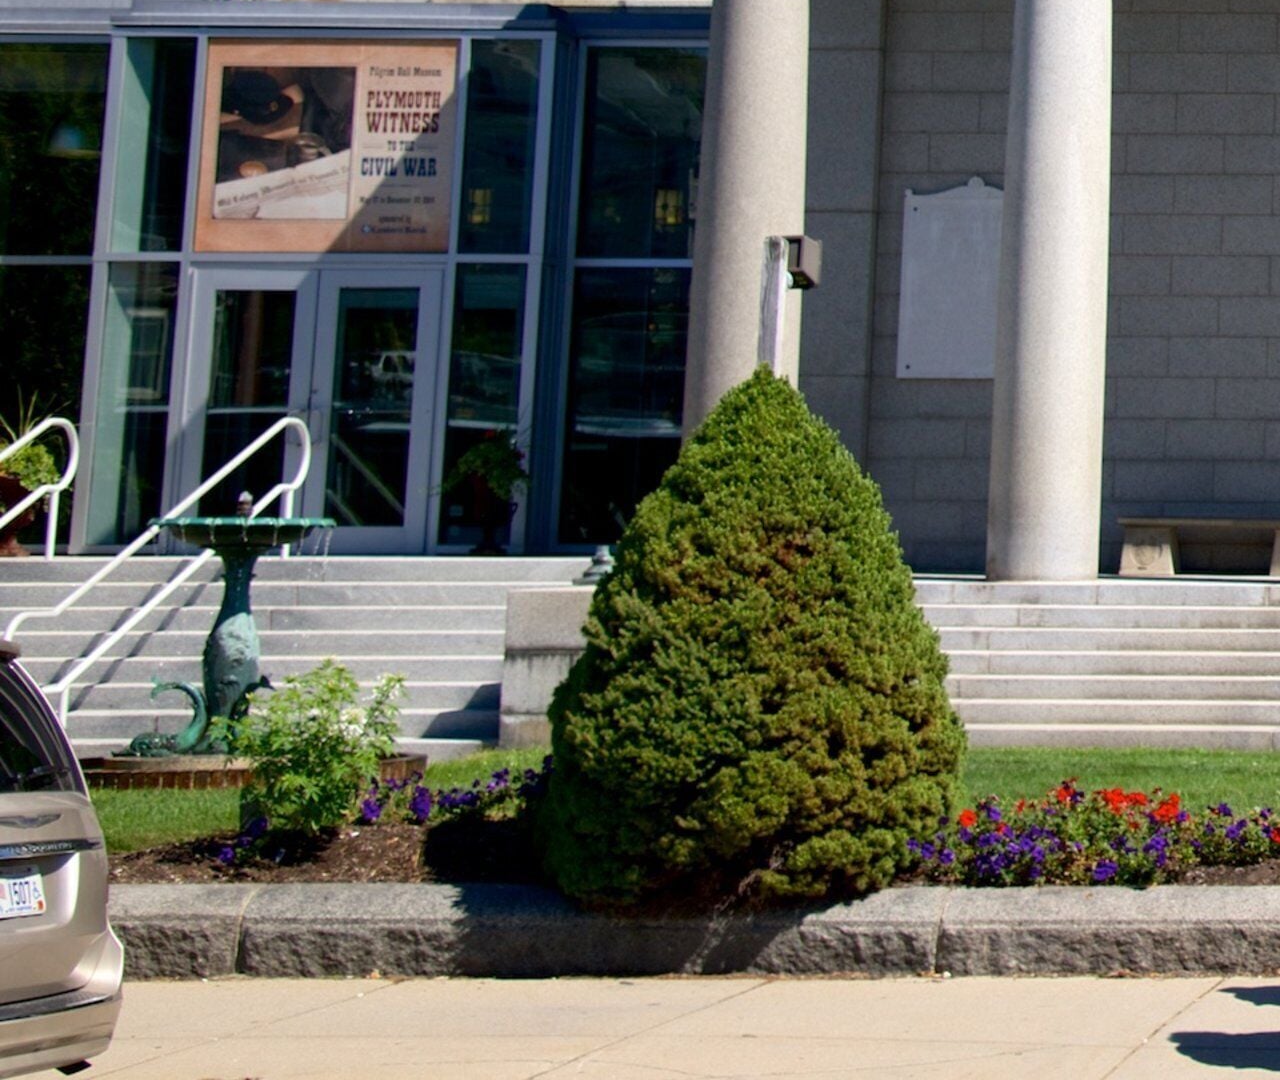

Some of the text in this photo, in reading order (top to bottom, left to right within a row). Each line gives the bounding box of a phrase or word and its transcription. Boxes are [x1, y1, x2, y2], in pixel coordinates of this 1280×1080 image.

[366, 90, 441, 109] PLYMOUTH
[366, 112, 440, 134] WITNESS
[361, 157, 437, 176] CIVIL WAR
